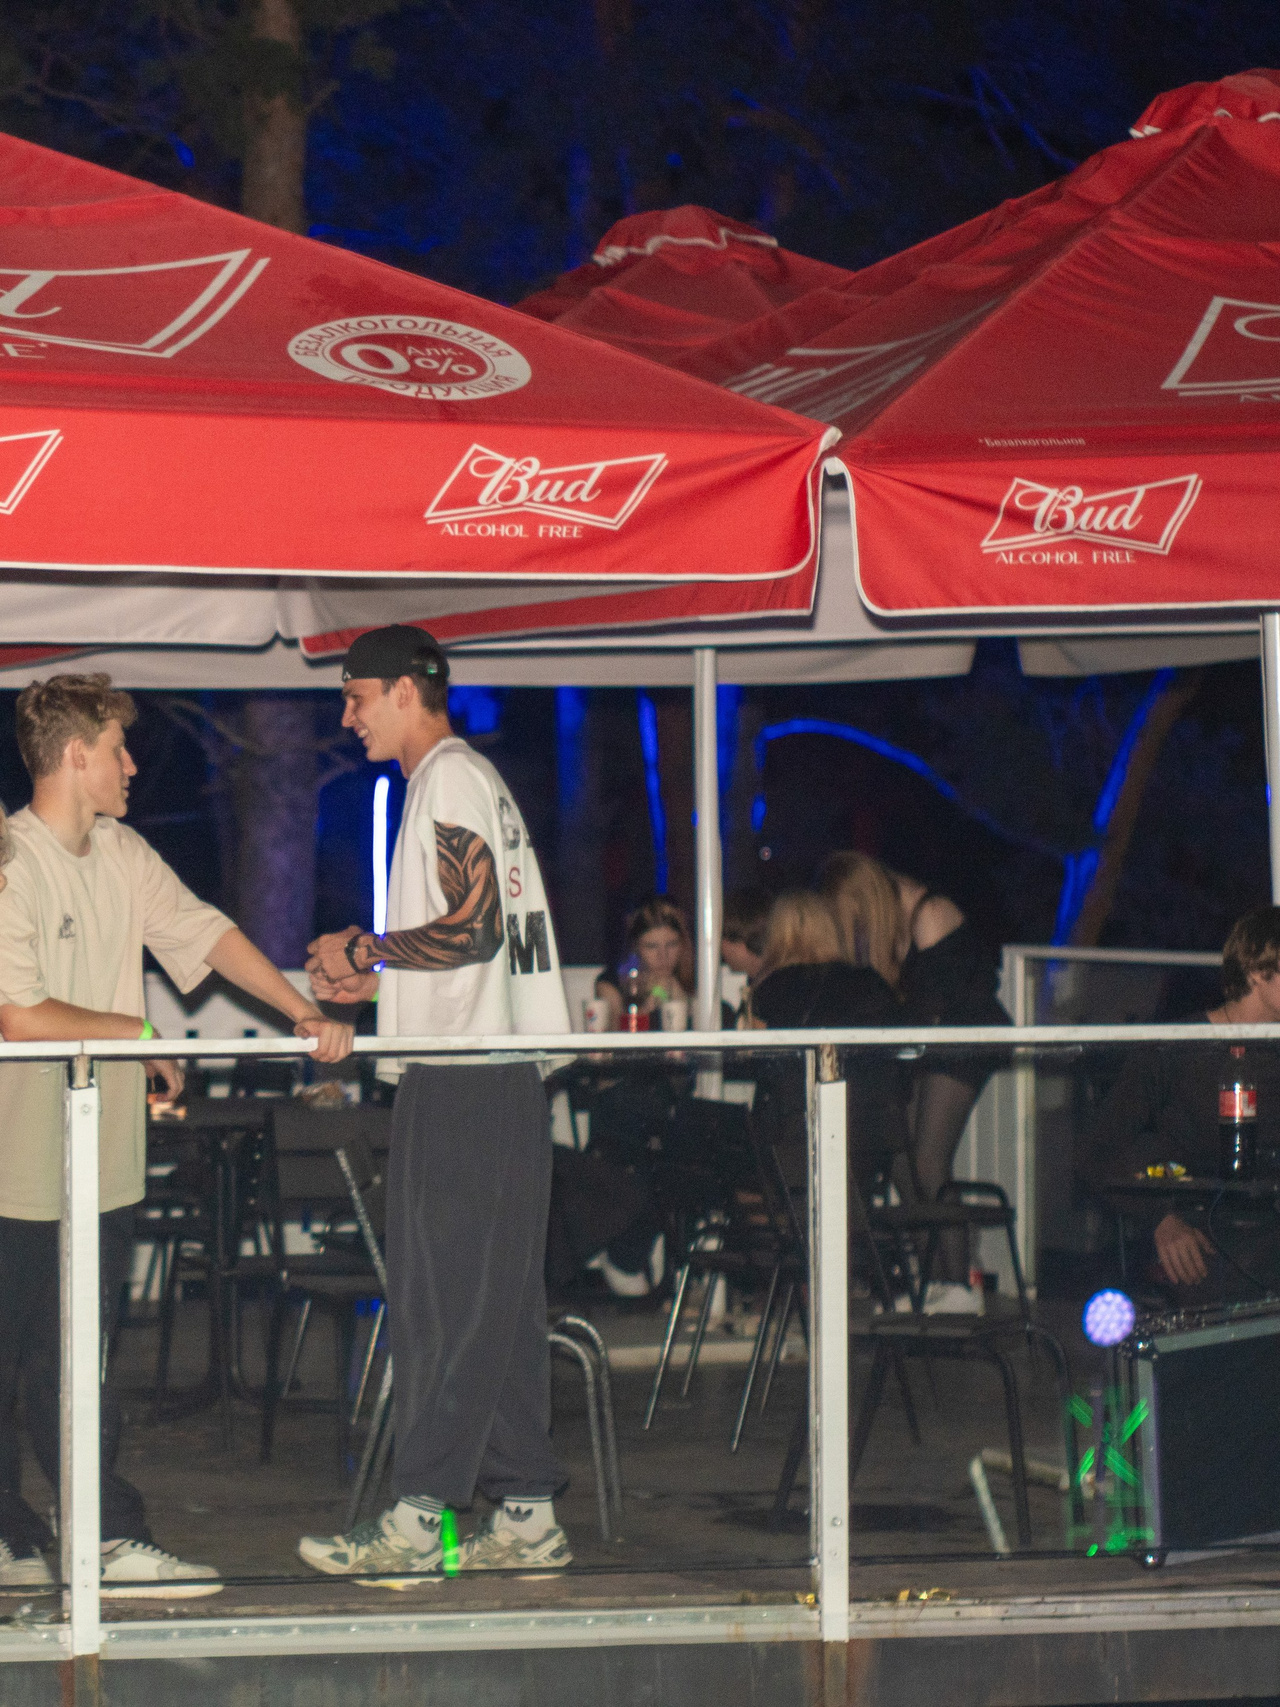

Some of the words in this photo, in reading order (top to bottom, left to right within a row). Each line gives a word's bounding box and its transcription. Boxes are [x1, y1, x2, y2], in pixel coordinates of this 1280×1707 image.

[294, 317, 513, 358] БЕЗАЛКОГОЛЬНАЯ
[469, 456, 602, 506] Bud
[440, 522, 529, 538] ALCOHOL
[538, 524, 583, 538] FREE
[1014, 485, 1143, 534] Bud
[995, 550, 1084, 565] ALCOHOL
[1092, 550, 1137, 564] FREE
